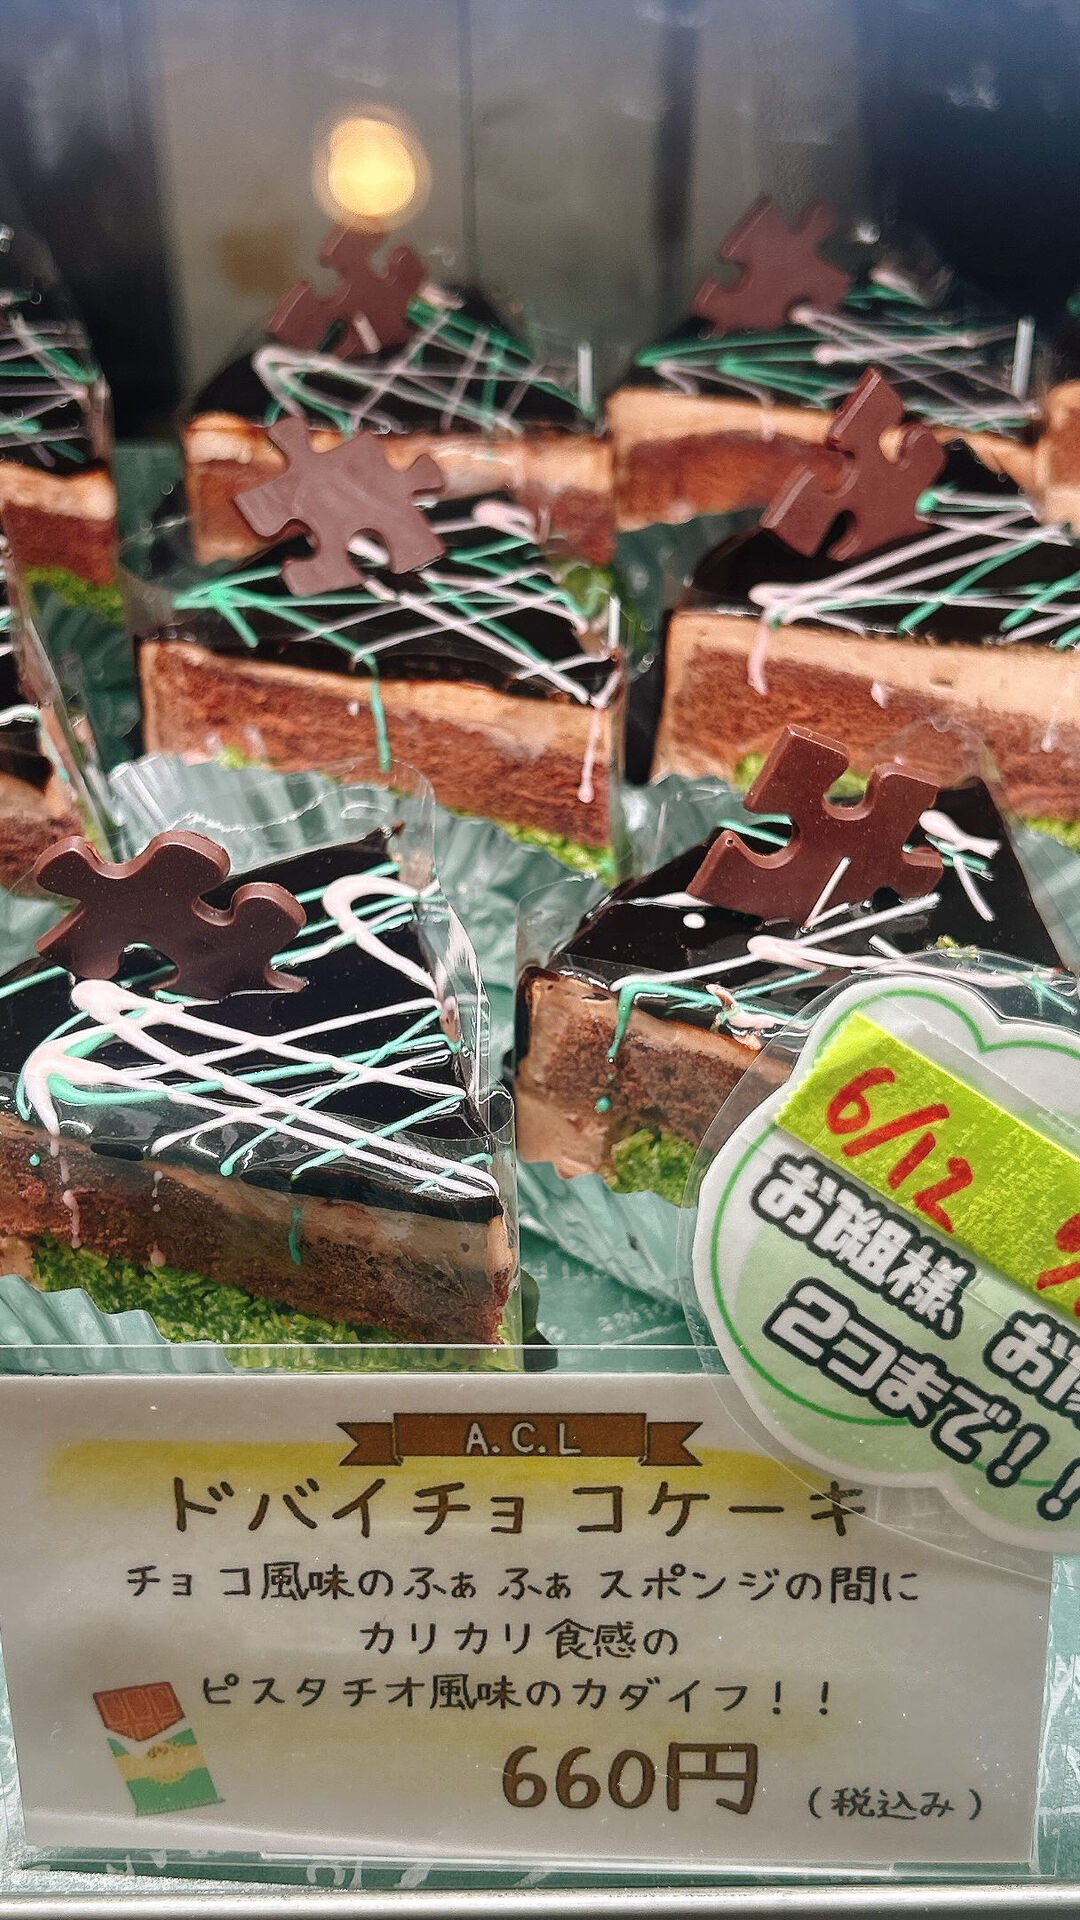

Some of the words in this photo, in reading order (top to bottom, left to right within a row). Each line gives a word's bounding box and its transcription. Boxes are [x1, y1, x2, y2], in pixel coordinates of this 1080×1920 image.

[826, 1066, 973, 1233] 6/12
[465, 1422, 581, 1455] A.C.L
[172, 1476, 866, 1538] ドバイチョコケーキ
[360, 1617, 678, 1660] カリカリ食感の
[502, 1742, 758, 1815] 660円
[807, 1785, 983, 1820] （税込み）
